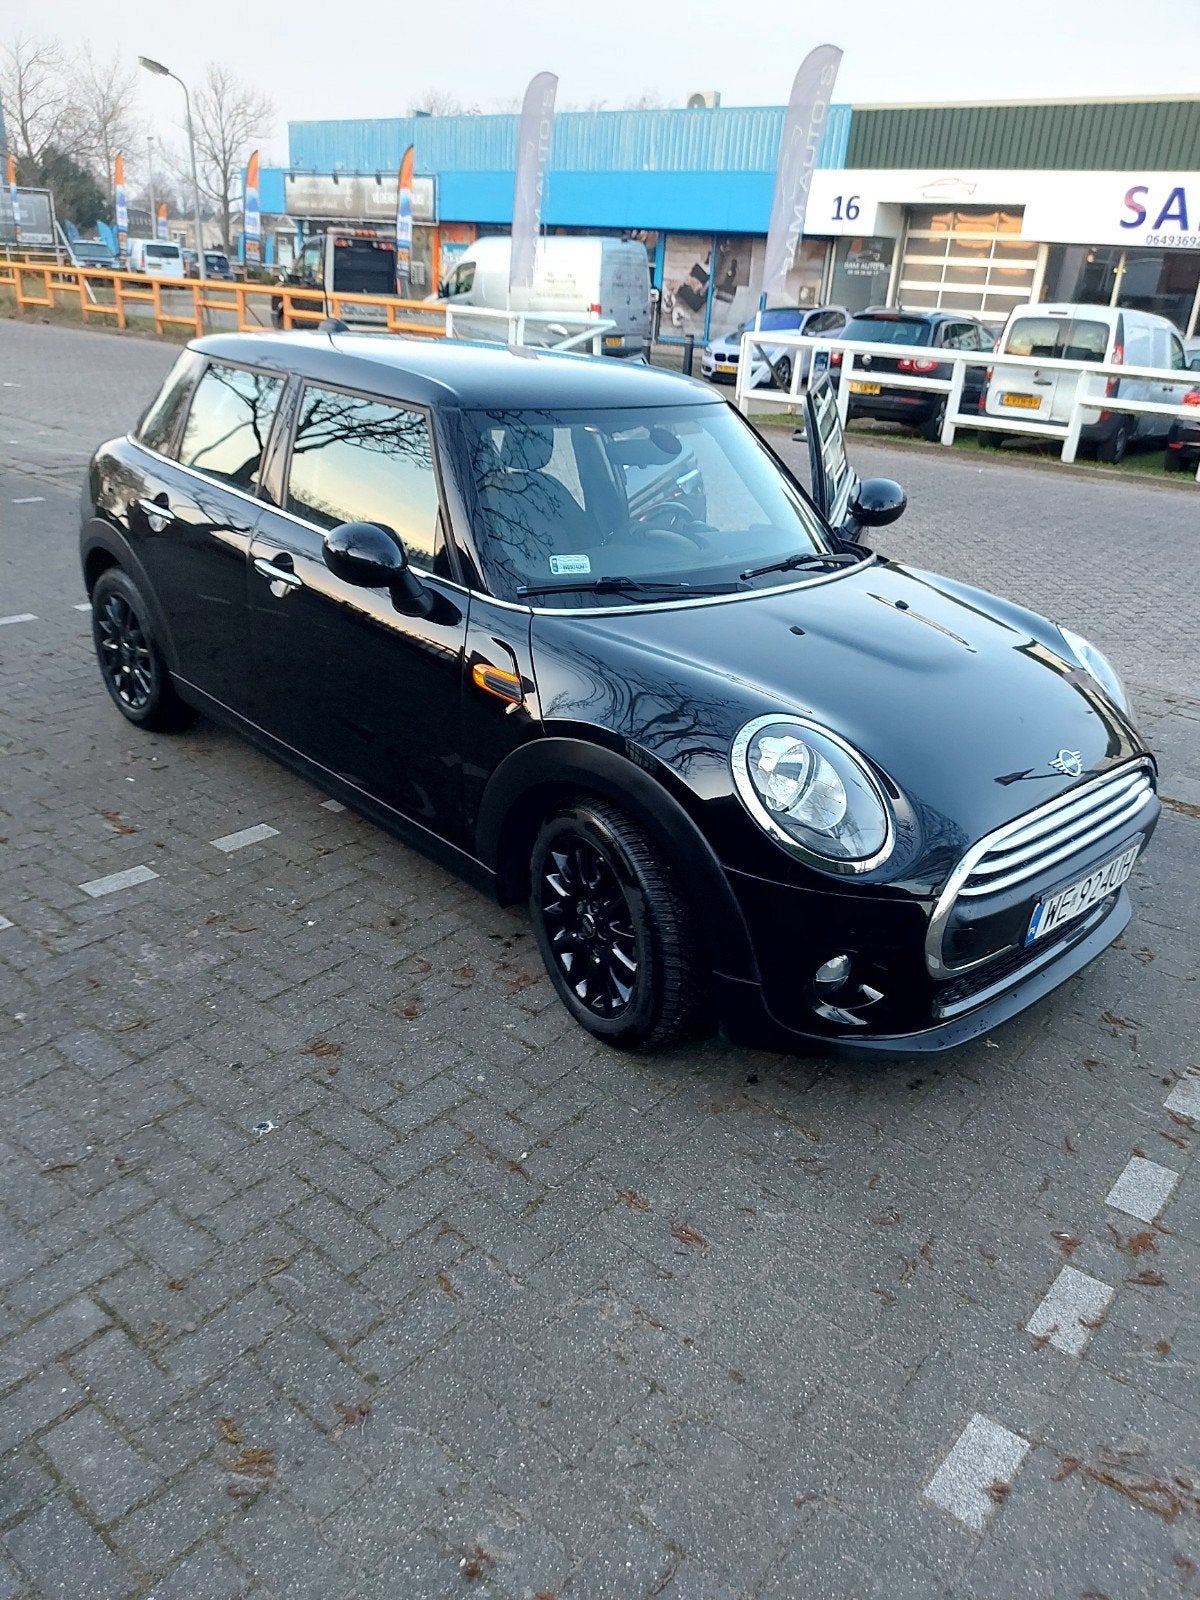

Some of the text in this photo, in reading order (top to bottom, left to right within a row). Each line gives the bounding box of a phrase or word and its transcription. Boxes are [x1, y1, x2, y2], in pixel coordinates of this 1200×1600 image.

[800, 64, 836, 192] AUTO'S
[831, 195, 860, 221] 16
[1119, 185, 1200, 231] SA
